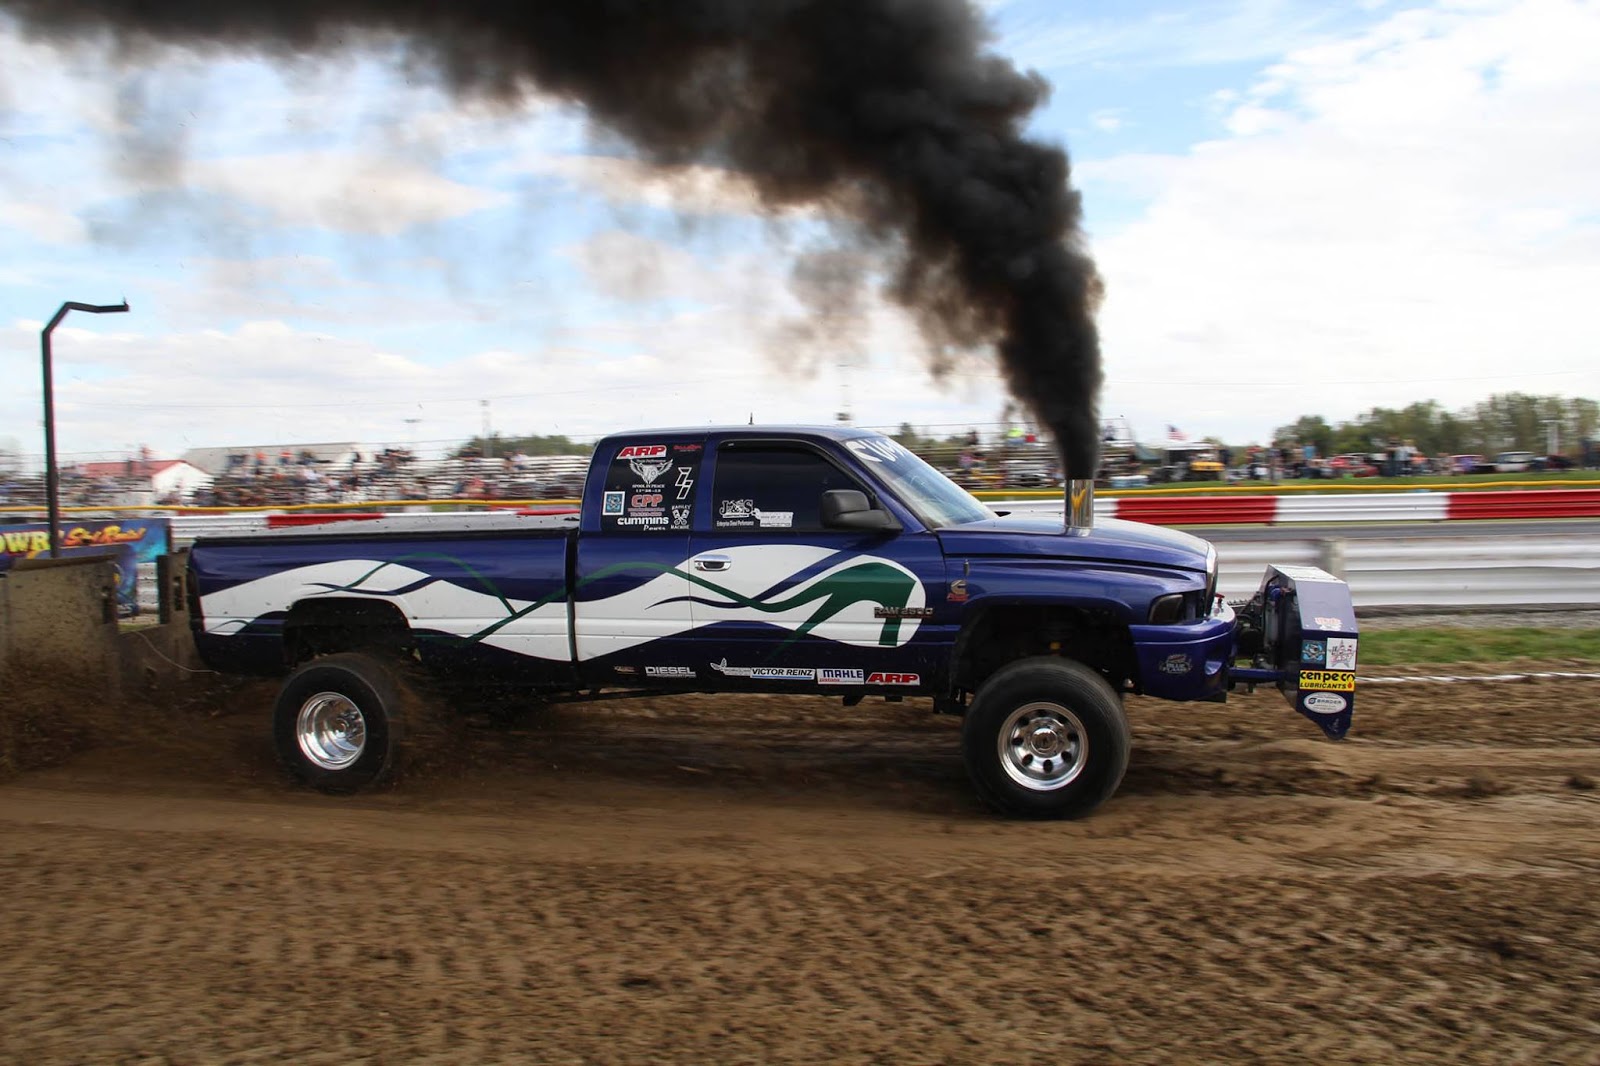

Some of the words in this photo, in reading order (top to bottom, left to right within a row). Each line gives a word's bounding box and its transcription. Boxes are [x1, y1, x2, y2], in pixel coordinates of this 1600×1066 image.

[619, 445, 666, 457] ARP
[631, 494, 663, 507] CPP
[645, 666, 695, 674] DIESEL
[752, 668, 784, 676] VICTOR
[822, 669, 863, 679] MAHLE
[868, 673, 918, 683] ARP
